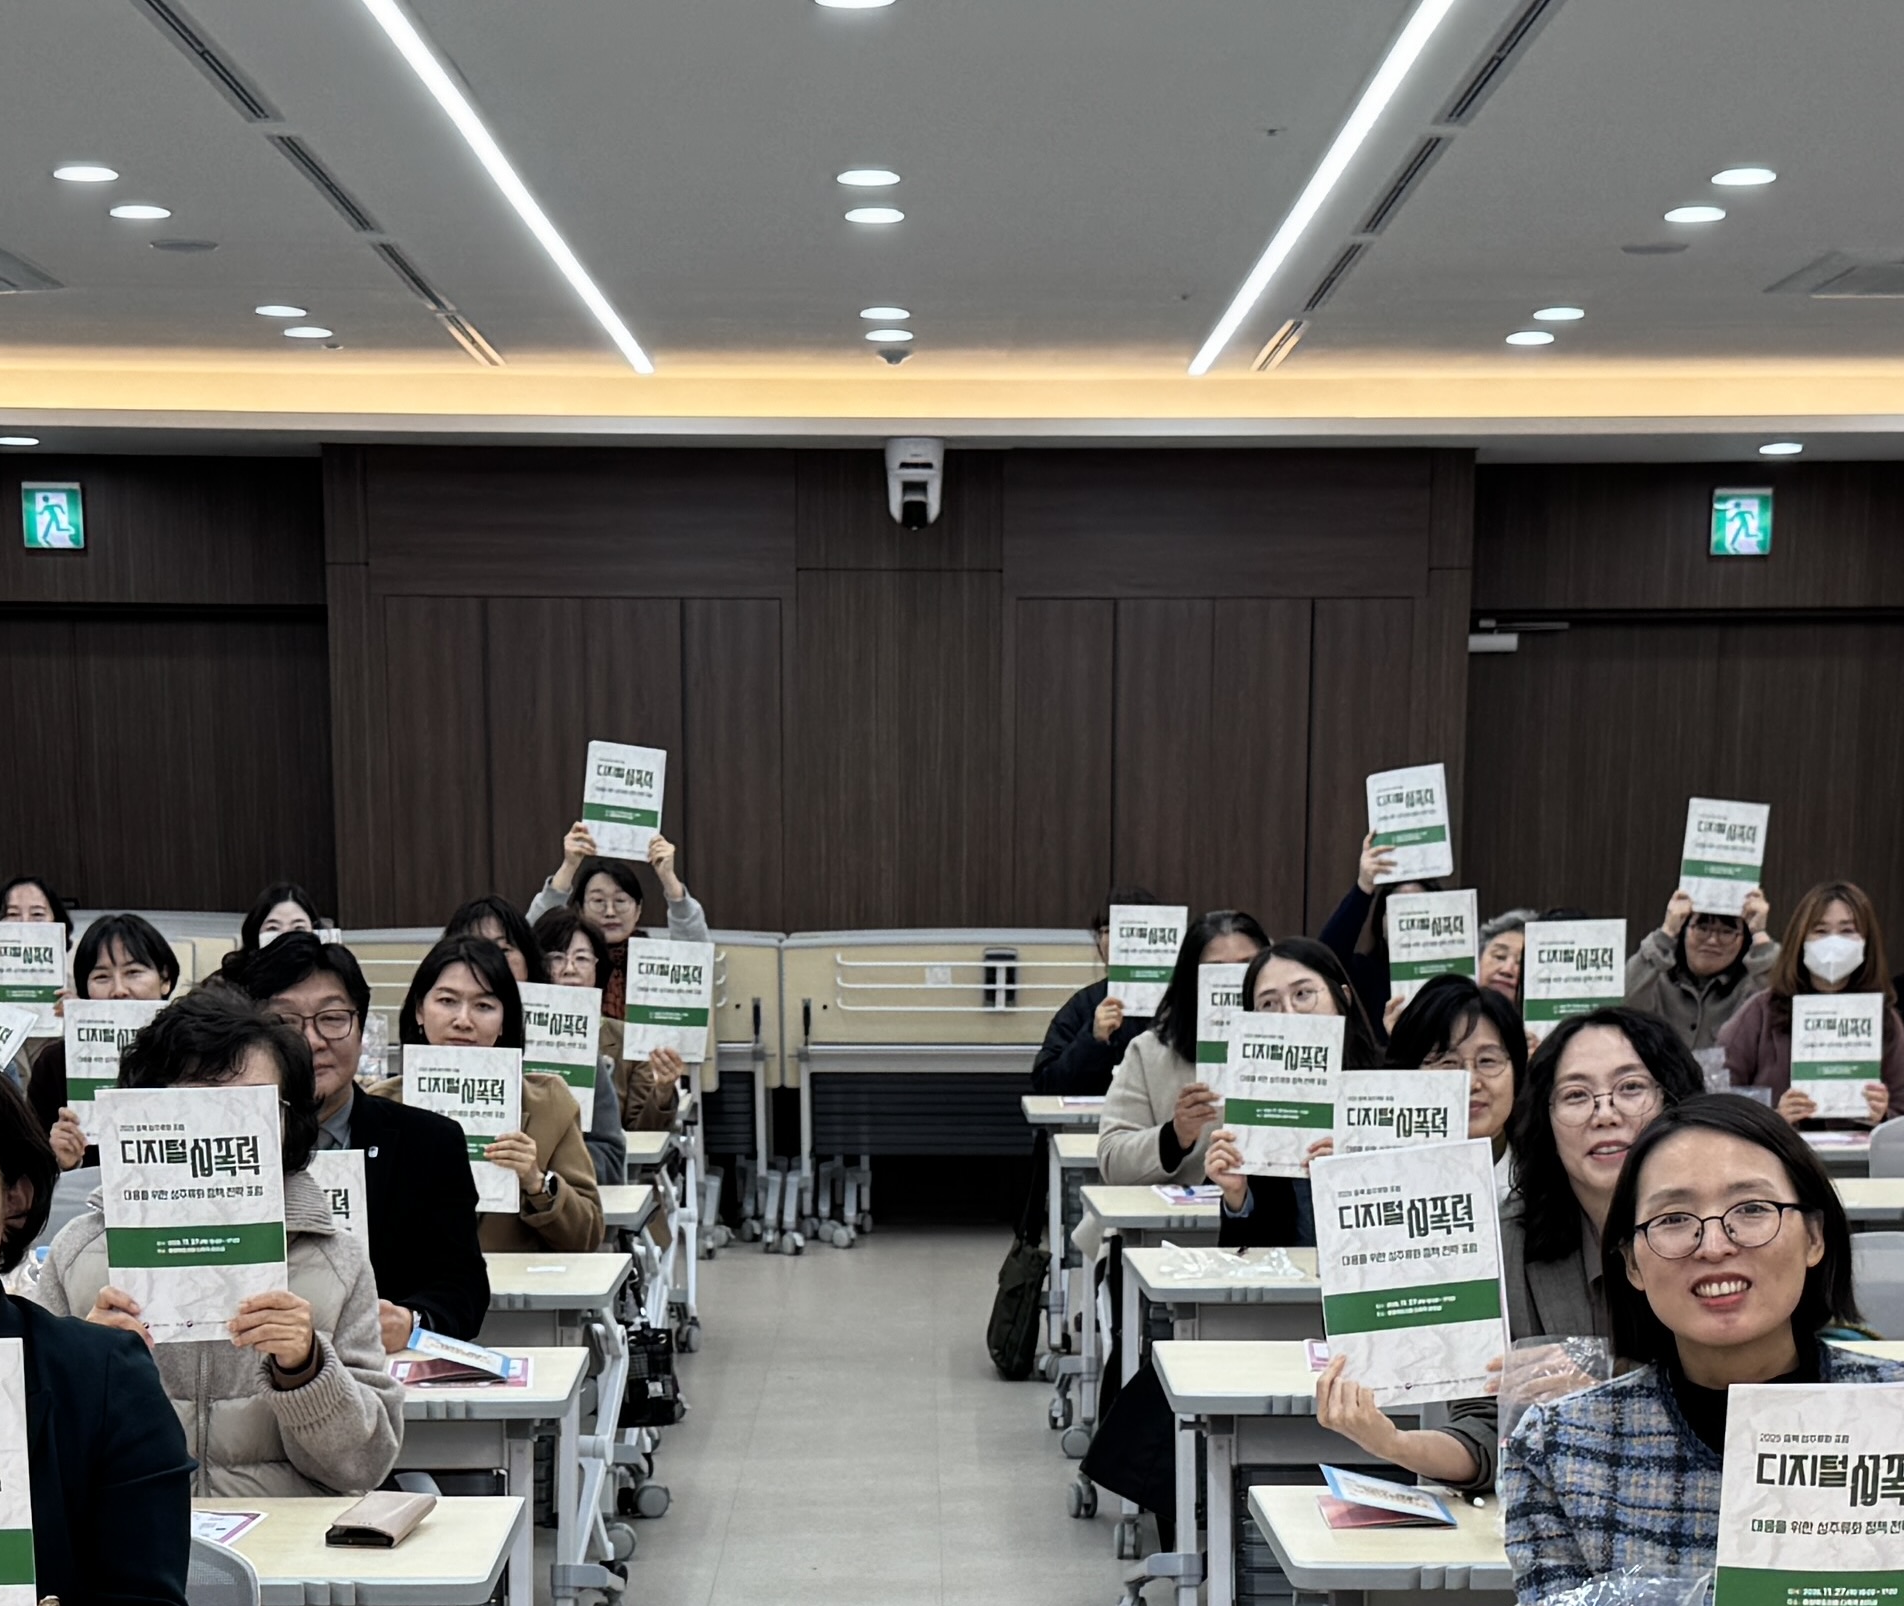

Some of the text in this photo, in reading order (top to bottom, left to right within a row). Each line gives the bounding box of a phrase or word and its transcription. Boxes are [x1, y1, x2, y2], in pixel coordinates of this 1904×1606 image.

[1538, 948, 1613, 970] 디지털 성폭력
[525, 1011, 548, 1026] 지털
[78, 1028, 114, 1042] 디지털
[1242, 1044, 1328, 1072] 디지털 성폭력
[418, 1077, 504, 1105] 디지털 성폭력
[1347, 1107, 1447, 1138] 디지털 성폭력
[120, 1136, 259, 1177] 디지털 성폭력
[1338, 1193, 1473, 1238] 디지털 성폭력
[1754, 1453, 1849, 1486] 디지털
[1790, 1520, 1813, 1534] 위한
